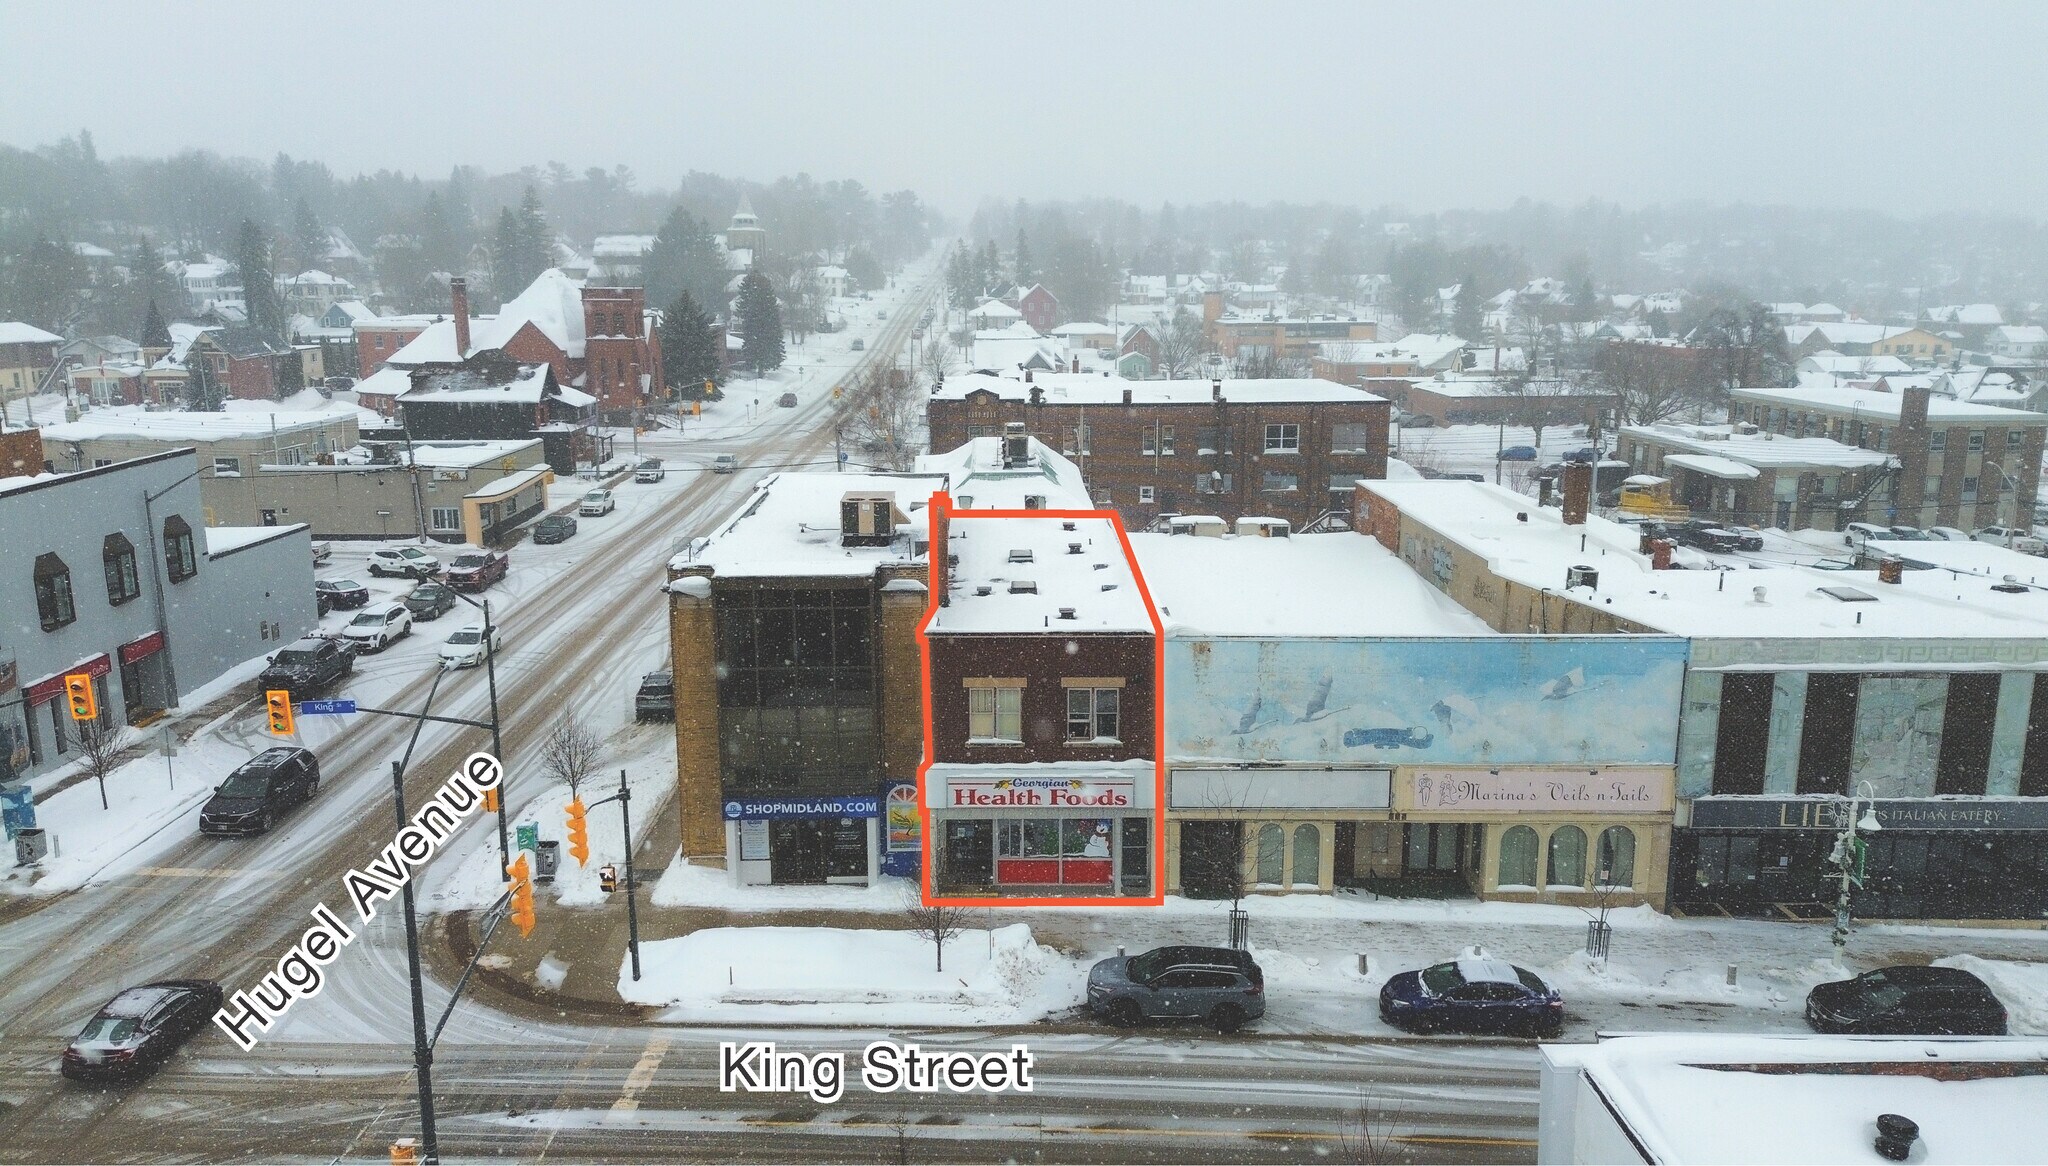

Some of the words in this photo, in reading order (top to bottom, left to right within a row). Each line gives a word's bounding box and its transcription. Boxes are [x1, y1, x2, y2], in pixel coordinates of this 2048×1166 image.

[314, 703, 334, 712] King
[1012, 778, 1070, 789] Georgian
[1458, 780, 1537, 801] Marina's
[1546, 781, 1591, 801] Veils
[1609, 781, 1653, 801] Tails
[953, 789, 1043, 806] Health
[1049, 788, 1128, 806] Foods
[745, 802, 877, 814] SHOPMIDLAND.COM
[1892, 809, 1948, 821] ITALIAN
[1951, 809, 2002, 821] EATERY
